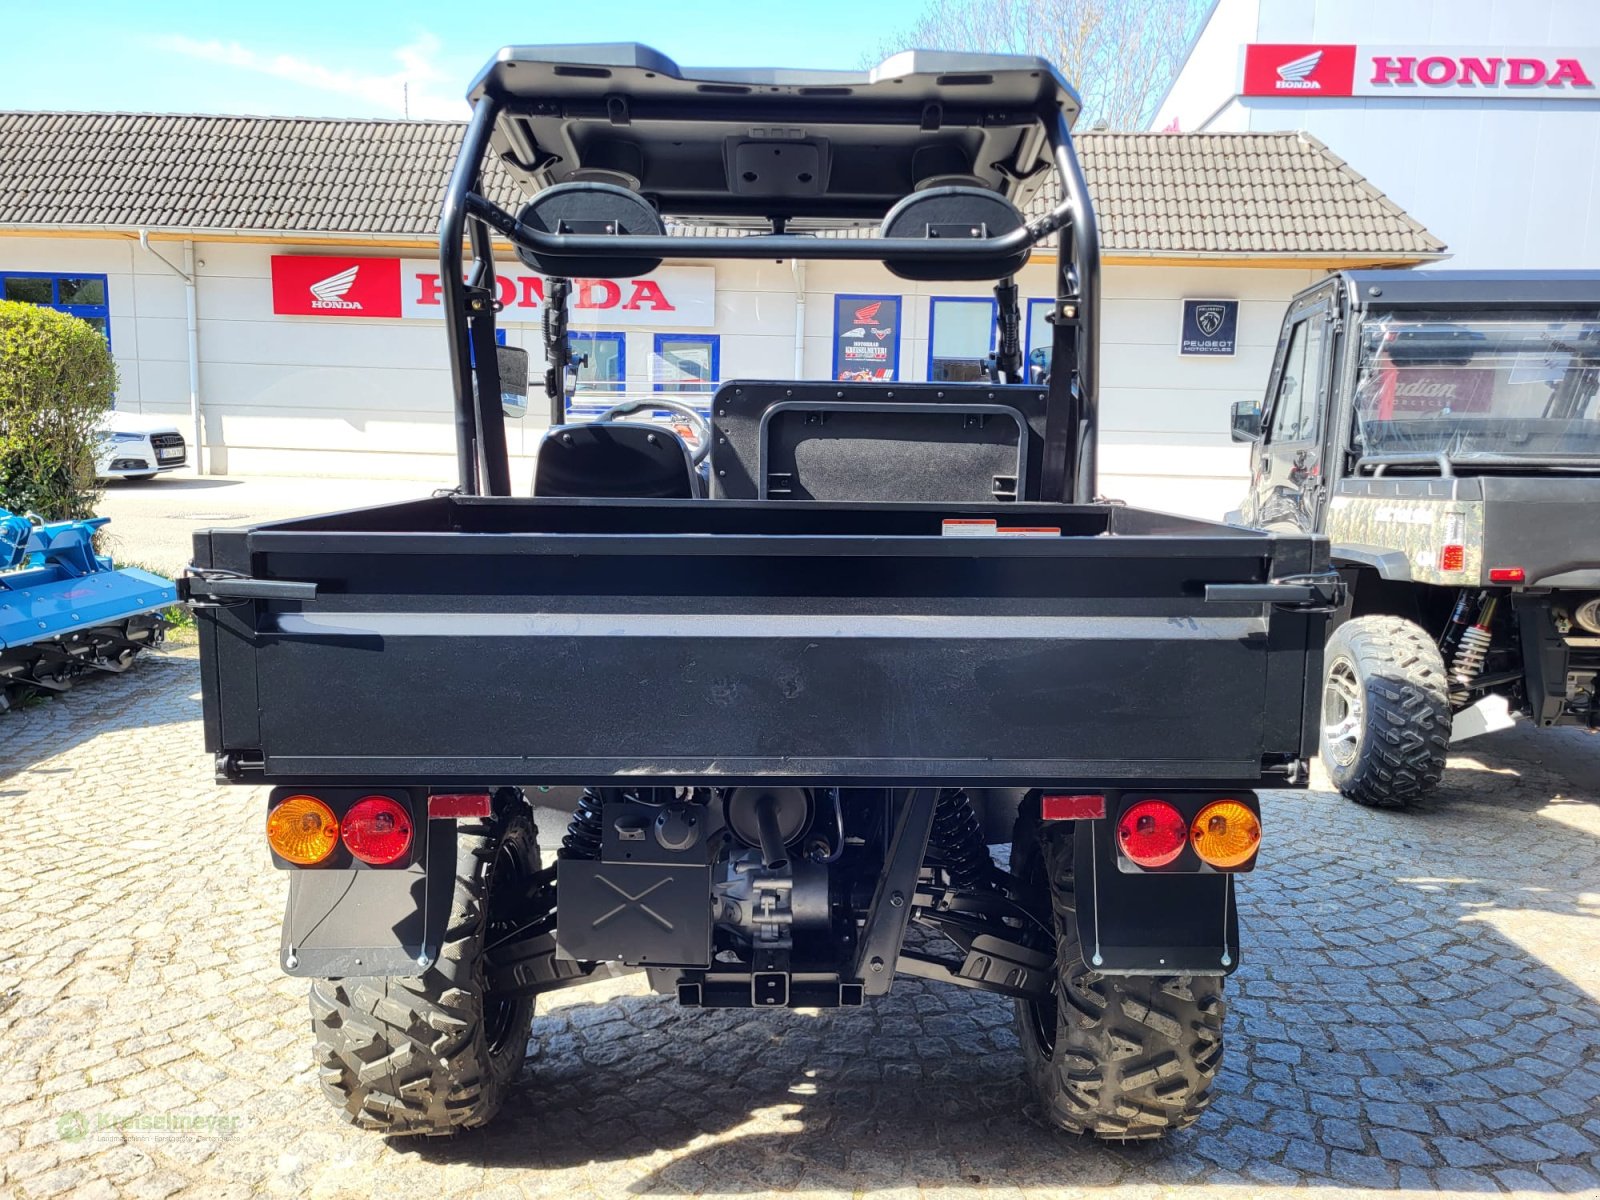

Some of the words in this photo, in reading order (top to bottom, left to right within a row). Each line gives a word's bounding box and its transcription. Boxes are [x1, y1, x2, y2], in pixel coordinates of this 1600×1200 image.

[1370, 56, 1594, 87] HONDA
[1275, 80, 1321, 89] HONDA
[311, 300, 363, 310] HONDA
